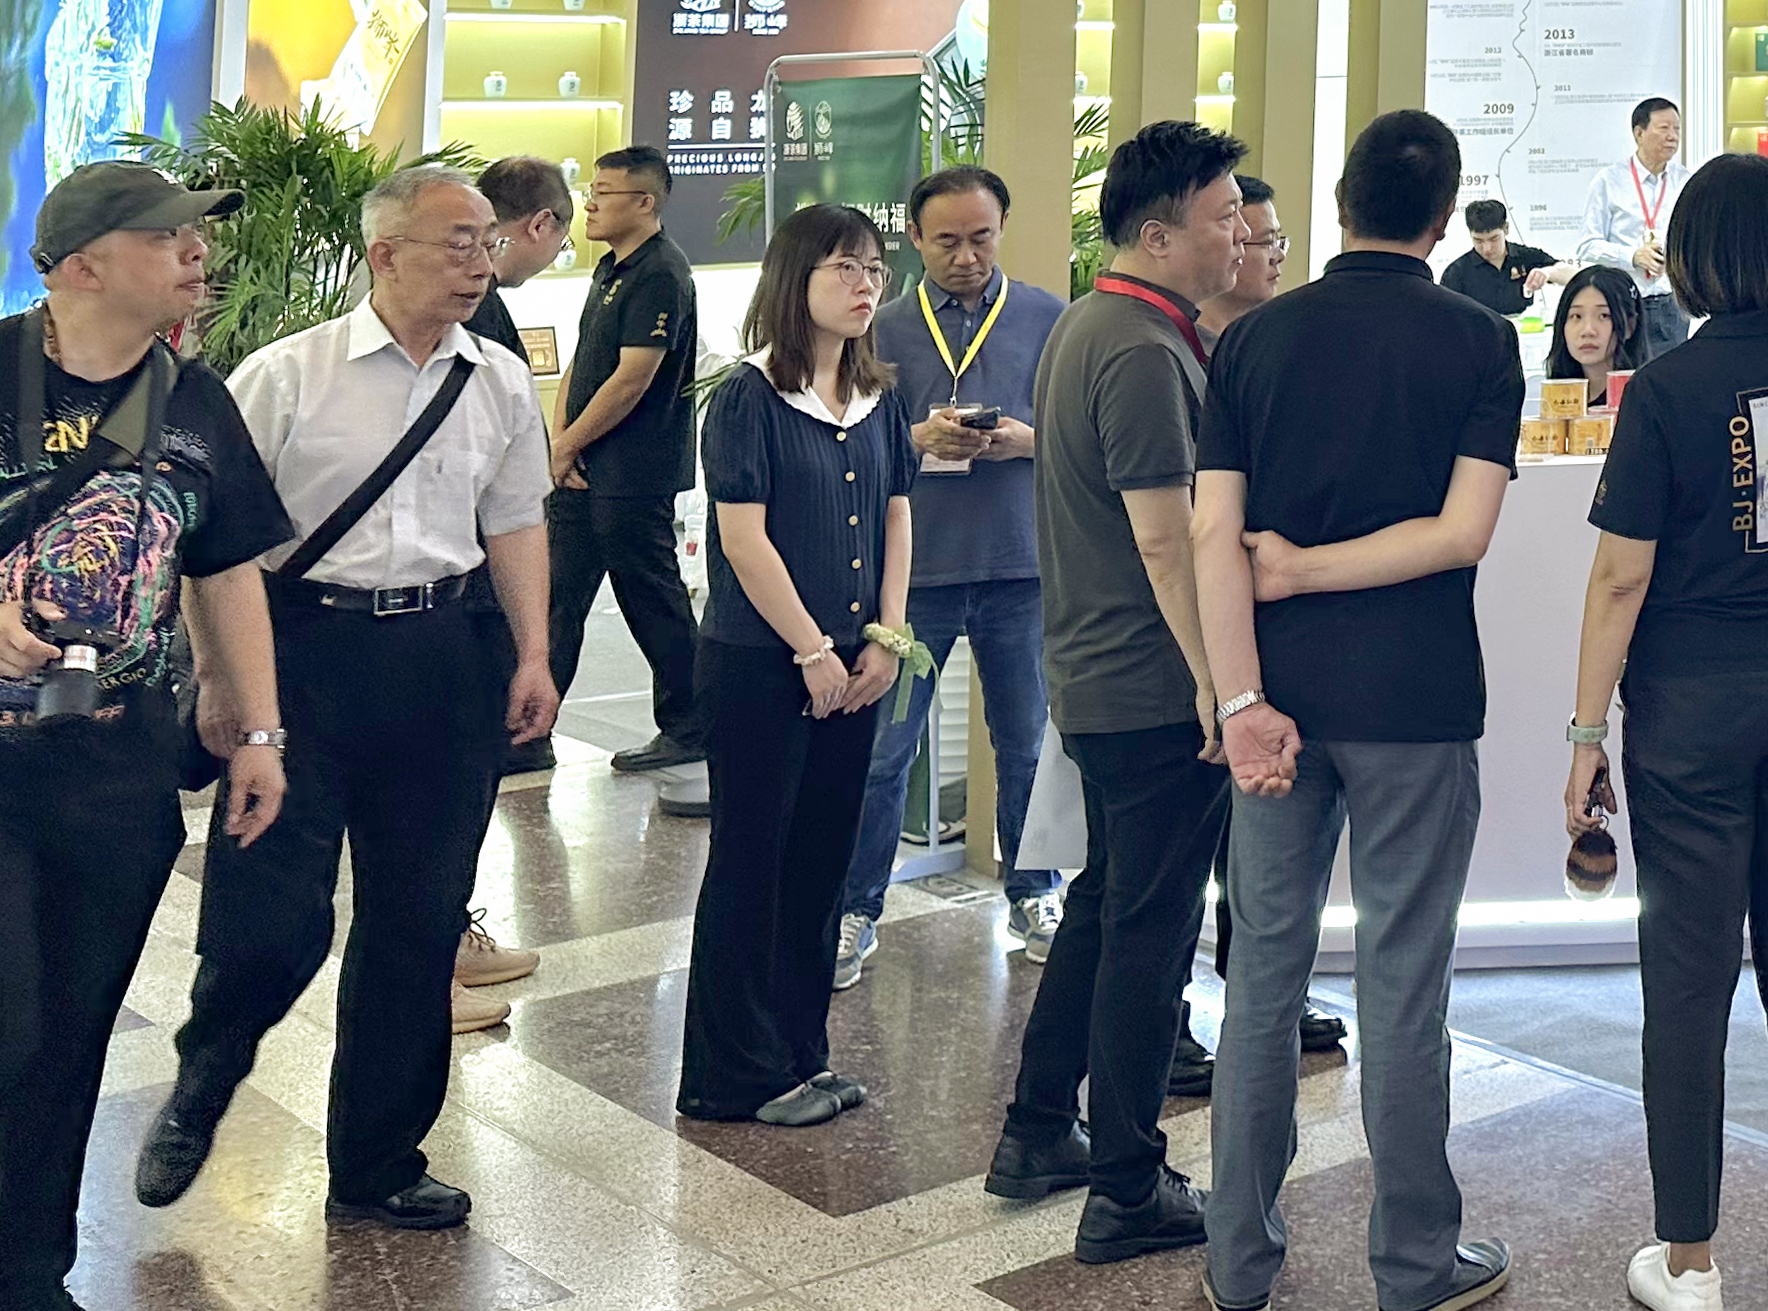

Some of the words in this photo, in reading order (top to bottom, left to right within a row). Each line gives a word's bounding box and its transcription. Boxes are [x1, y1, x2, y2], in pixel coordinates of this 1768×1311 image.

[1544, 28, 1576, 40] 2013
[1483, 103, 1515, 115] 2009
[666, 153, 724, 164] PRECIOUS
[731, 164, 760, 174] FROM
[1460, 175, 1489, 187] 1997
